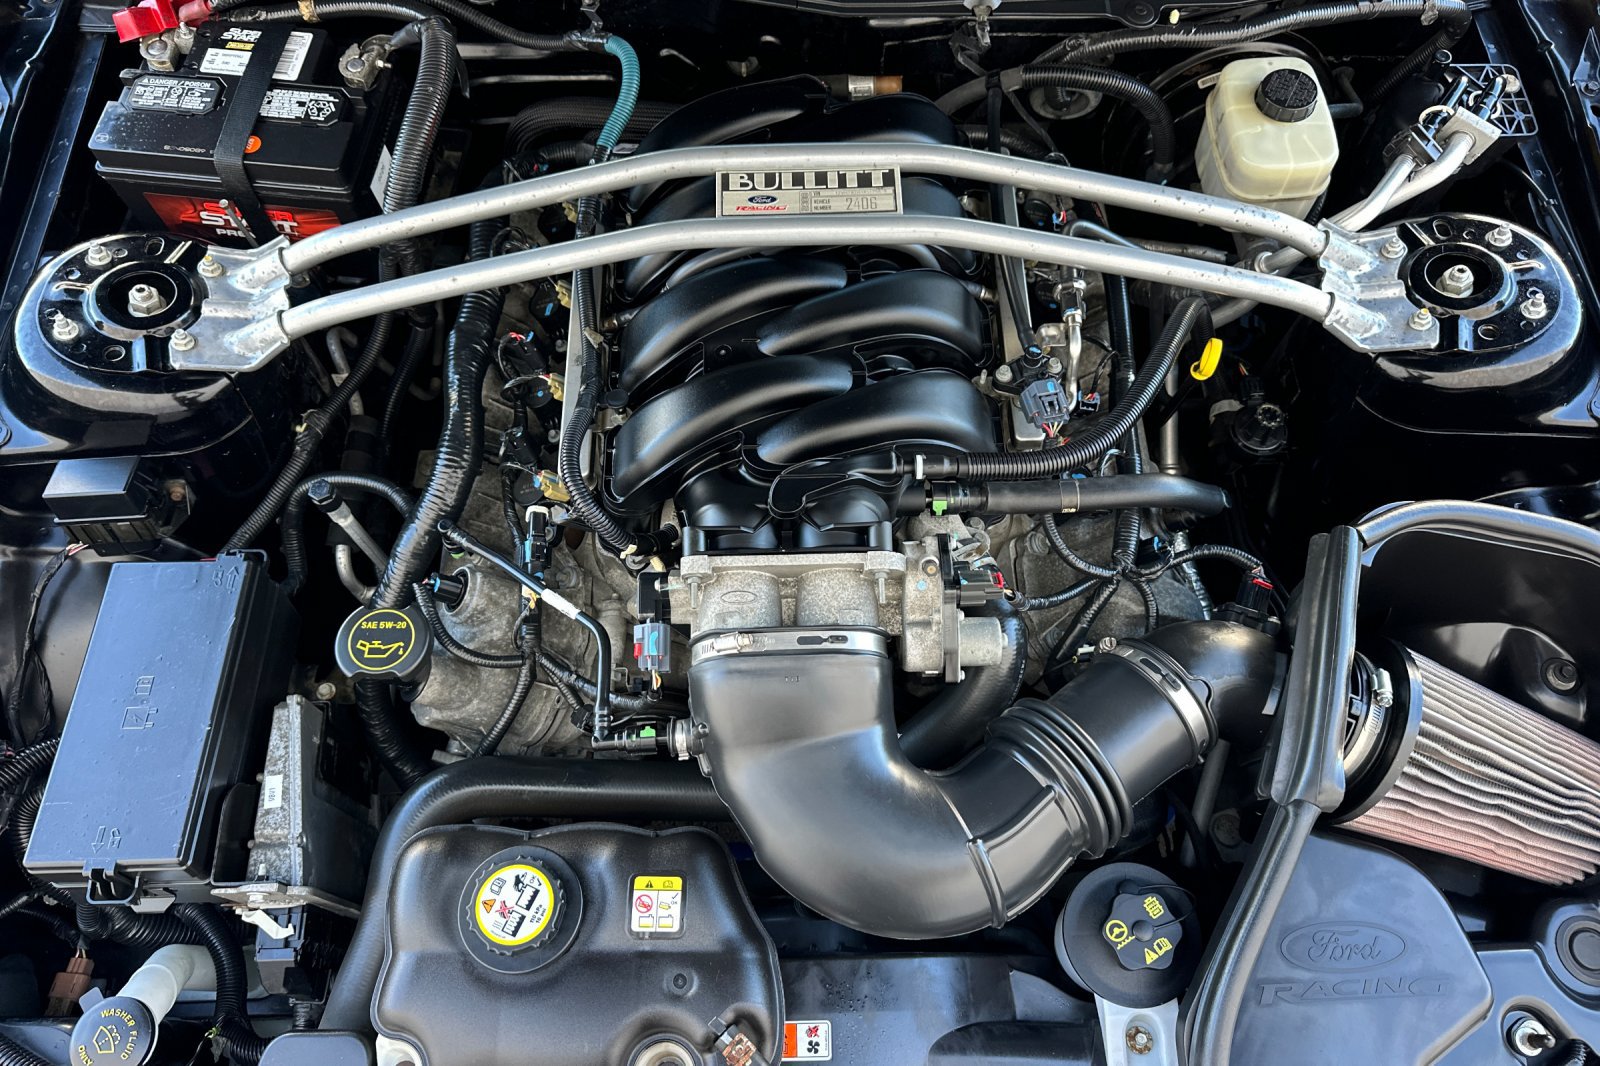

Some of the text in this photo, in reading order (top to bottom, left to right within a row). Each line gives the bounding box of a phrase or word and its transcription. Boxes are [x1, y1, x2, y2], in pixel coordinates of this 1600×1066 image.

[149, 78, 179, 86] DANGER
[184, 80, 211, 88] POISON
[729, 169, 889, 191] BULLITT
[752, 196, 773, 204] Ford
[845, 196, 878, 211] 2406
[361, 621, 407, 629] SAE 5W-20
[1307, 929, 1382, 962] Ford
[1258, 975, 1450, 1006] RACING
[78, 1007, 138, 1066] WASHER FLUID ONLY
